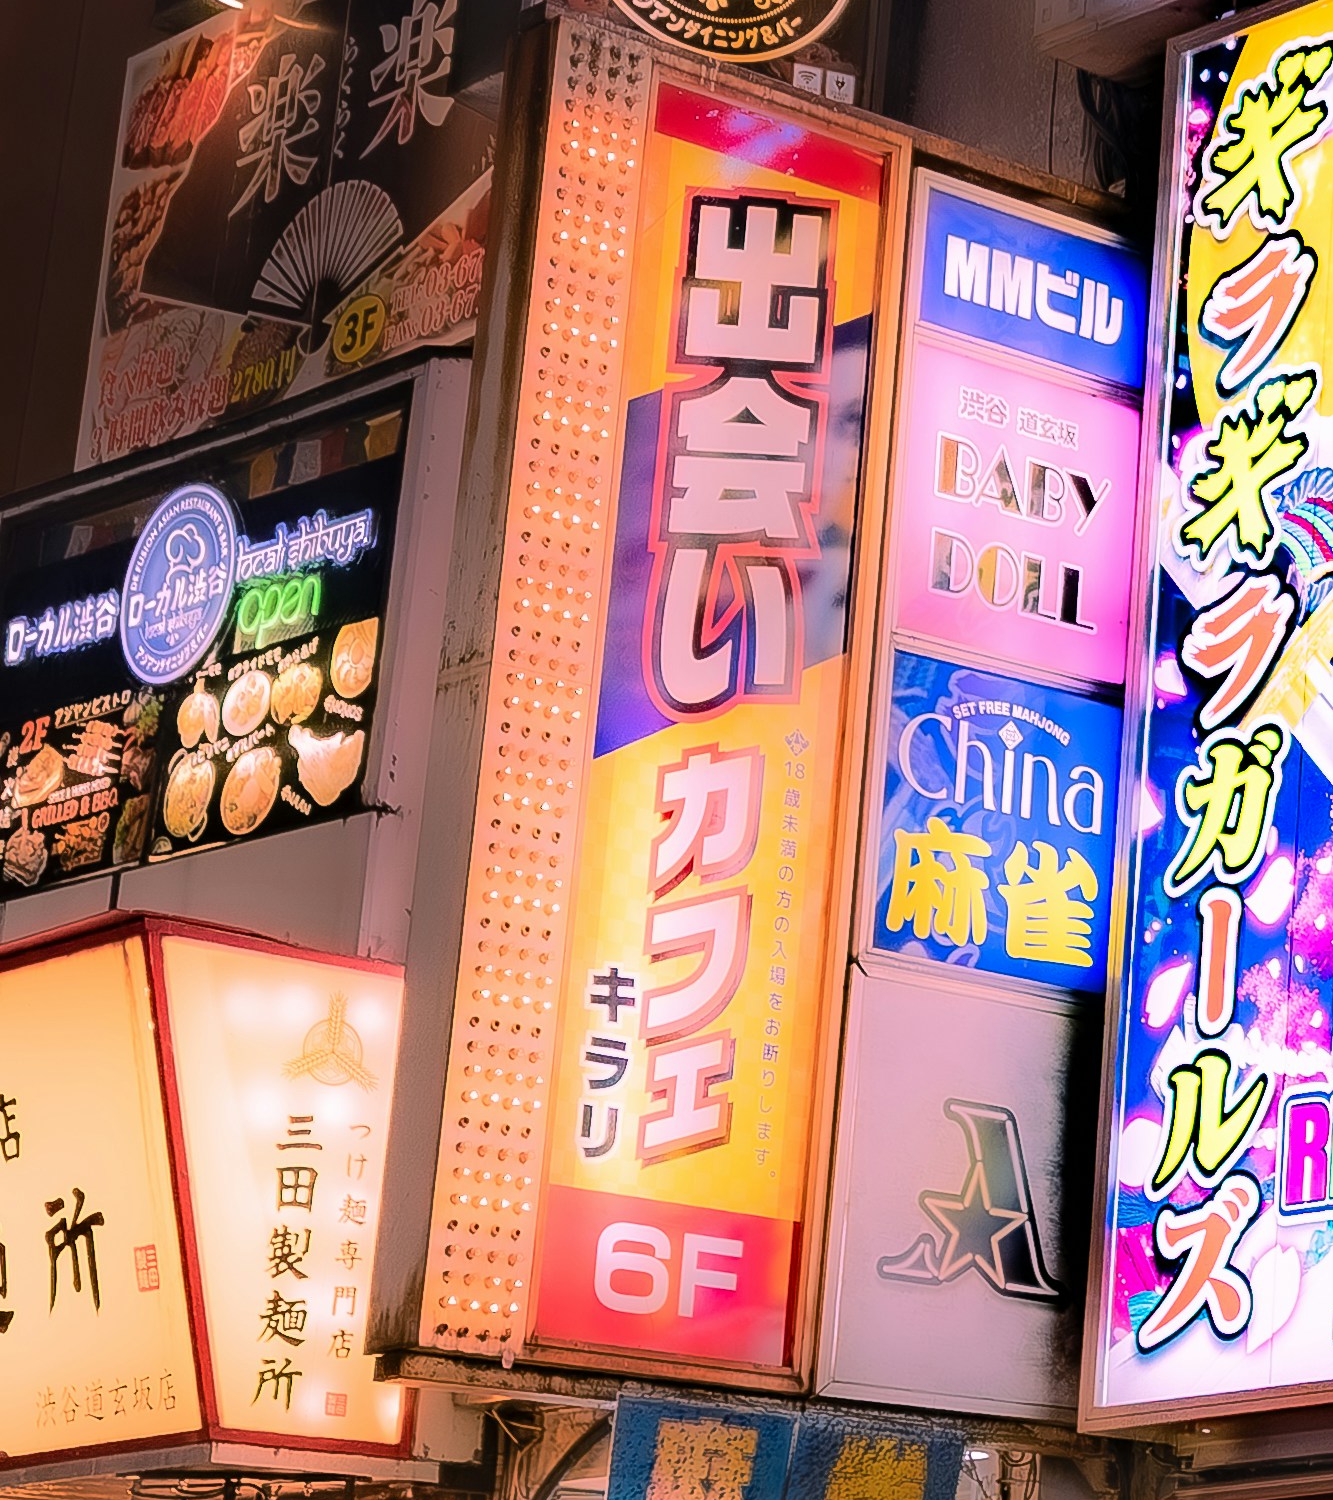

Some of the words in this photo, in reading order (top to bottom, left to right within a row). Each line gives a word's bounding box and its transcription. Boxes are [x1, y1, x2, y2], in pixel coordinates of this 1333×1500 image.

[341, 306, 377, 353] 3F
[941, 232, 1125, 346] MMビル
[231, 346, 295, 403] 2780円
[960, 387, 1010, 425] 渋谷
[1016, 408, 1079, 450] 道玄坂
[935, 431, 1112, 535] BABY
[129, 566, 227, 627] ローカル渋谷
[236, 529, 286, 582] local
[288, 512, 369, 570] shibuya
[928, 526, 1099, 635] DOLL
[7, 592, 117, 663] ローカル渋谷
[239, 575, 321, 650] open
[20, 716, 50, 750] 2F
[638, 193, 836, 1172] 出会いカフェ
[952, 700, 977, 718] SET
[978, 700, 1012, 715] FREE
[1012, 704, 1072, 749] MAHJONG
[1139, 39, 1333, 1354] ギラギラガールズ
[896, 711, 1108, 836] China
[885, 825, 1097, 968] 麻雀
[754, 761, 806, 1178] 18歳未満の方の入場をお断りします。
[579, 966, 636, 1161] キラリ
[253, 1113, 323, 1411] 三田製麺所
[326, 1123, 371, 1359] つけ麺専門店
[590, 1221, 746, 1320] 6F
[37, 1368, 178, 1427] 渋谷道玄坂店
